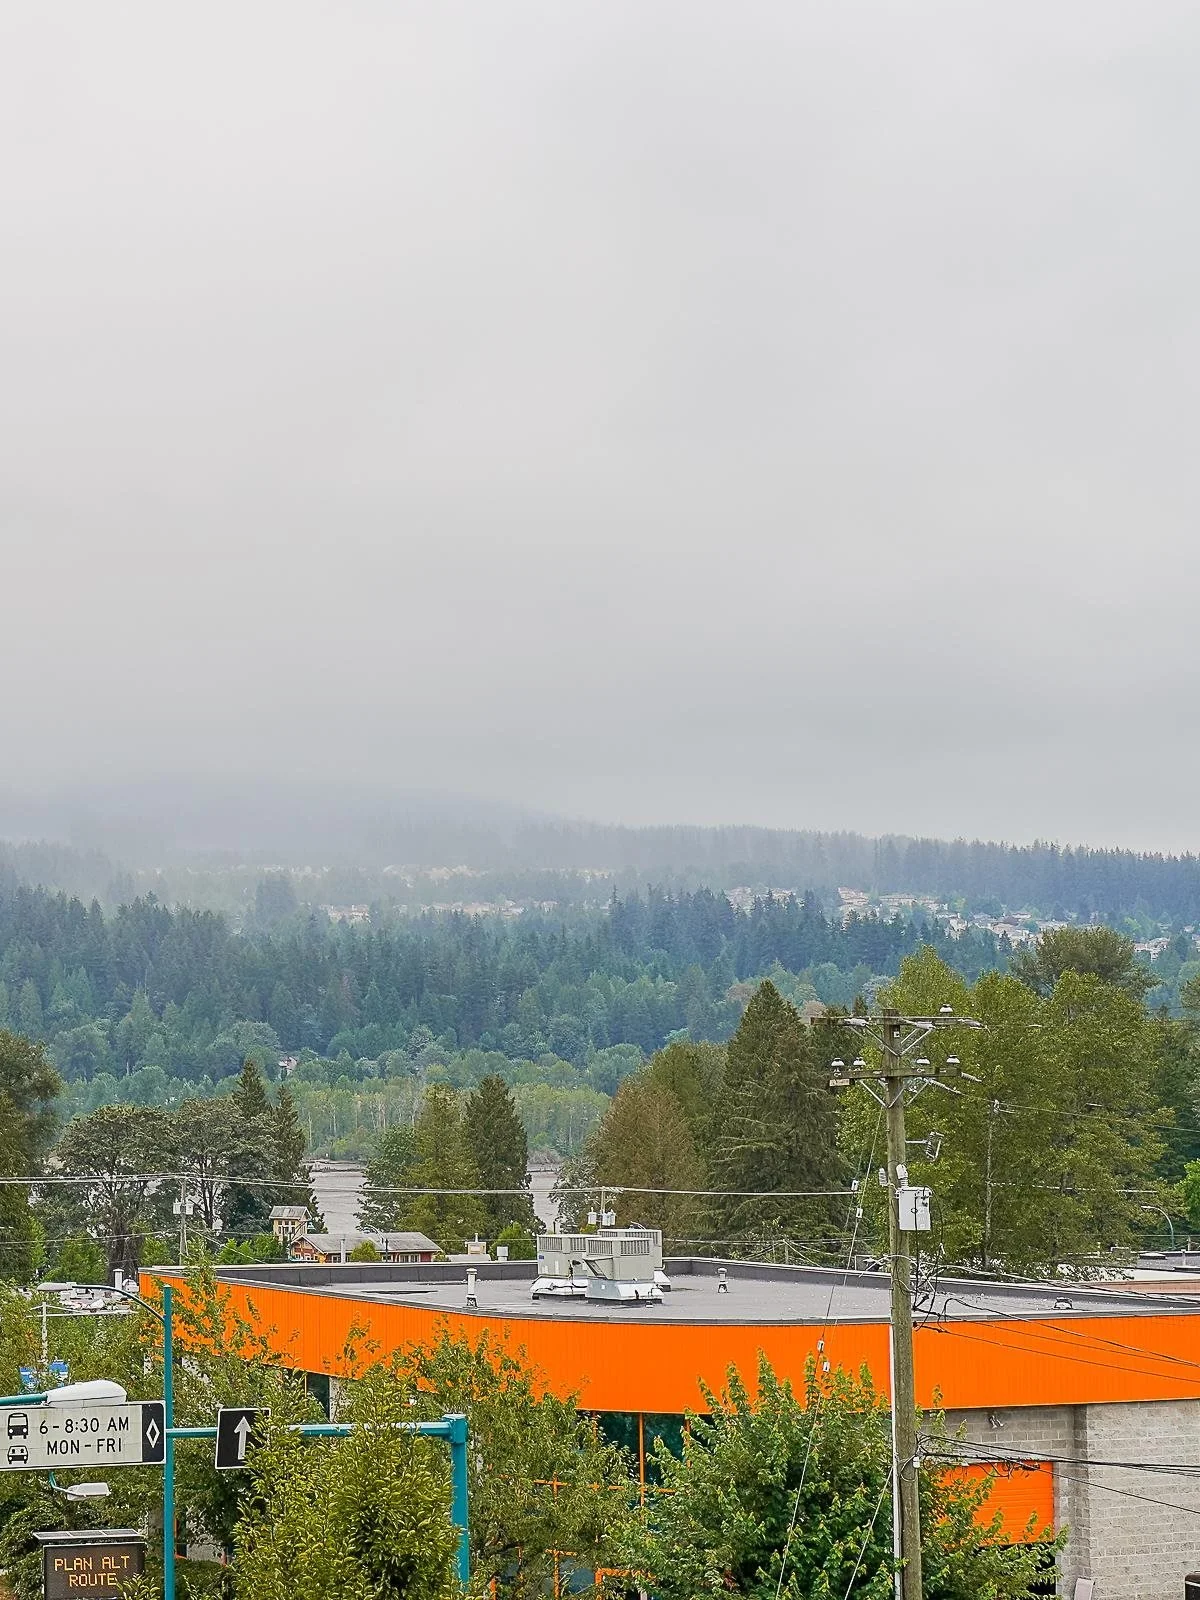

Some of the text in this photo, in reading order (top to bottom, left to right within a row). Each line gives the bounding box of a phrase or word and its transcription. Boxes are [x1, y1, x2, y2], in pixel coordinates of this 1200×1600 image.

[106, 1416, 129, 1432] AM
[54, 1555, 130, 1572] PLAN ALT
[69, 1572, 117, 1588] ROUTE
